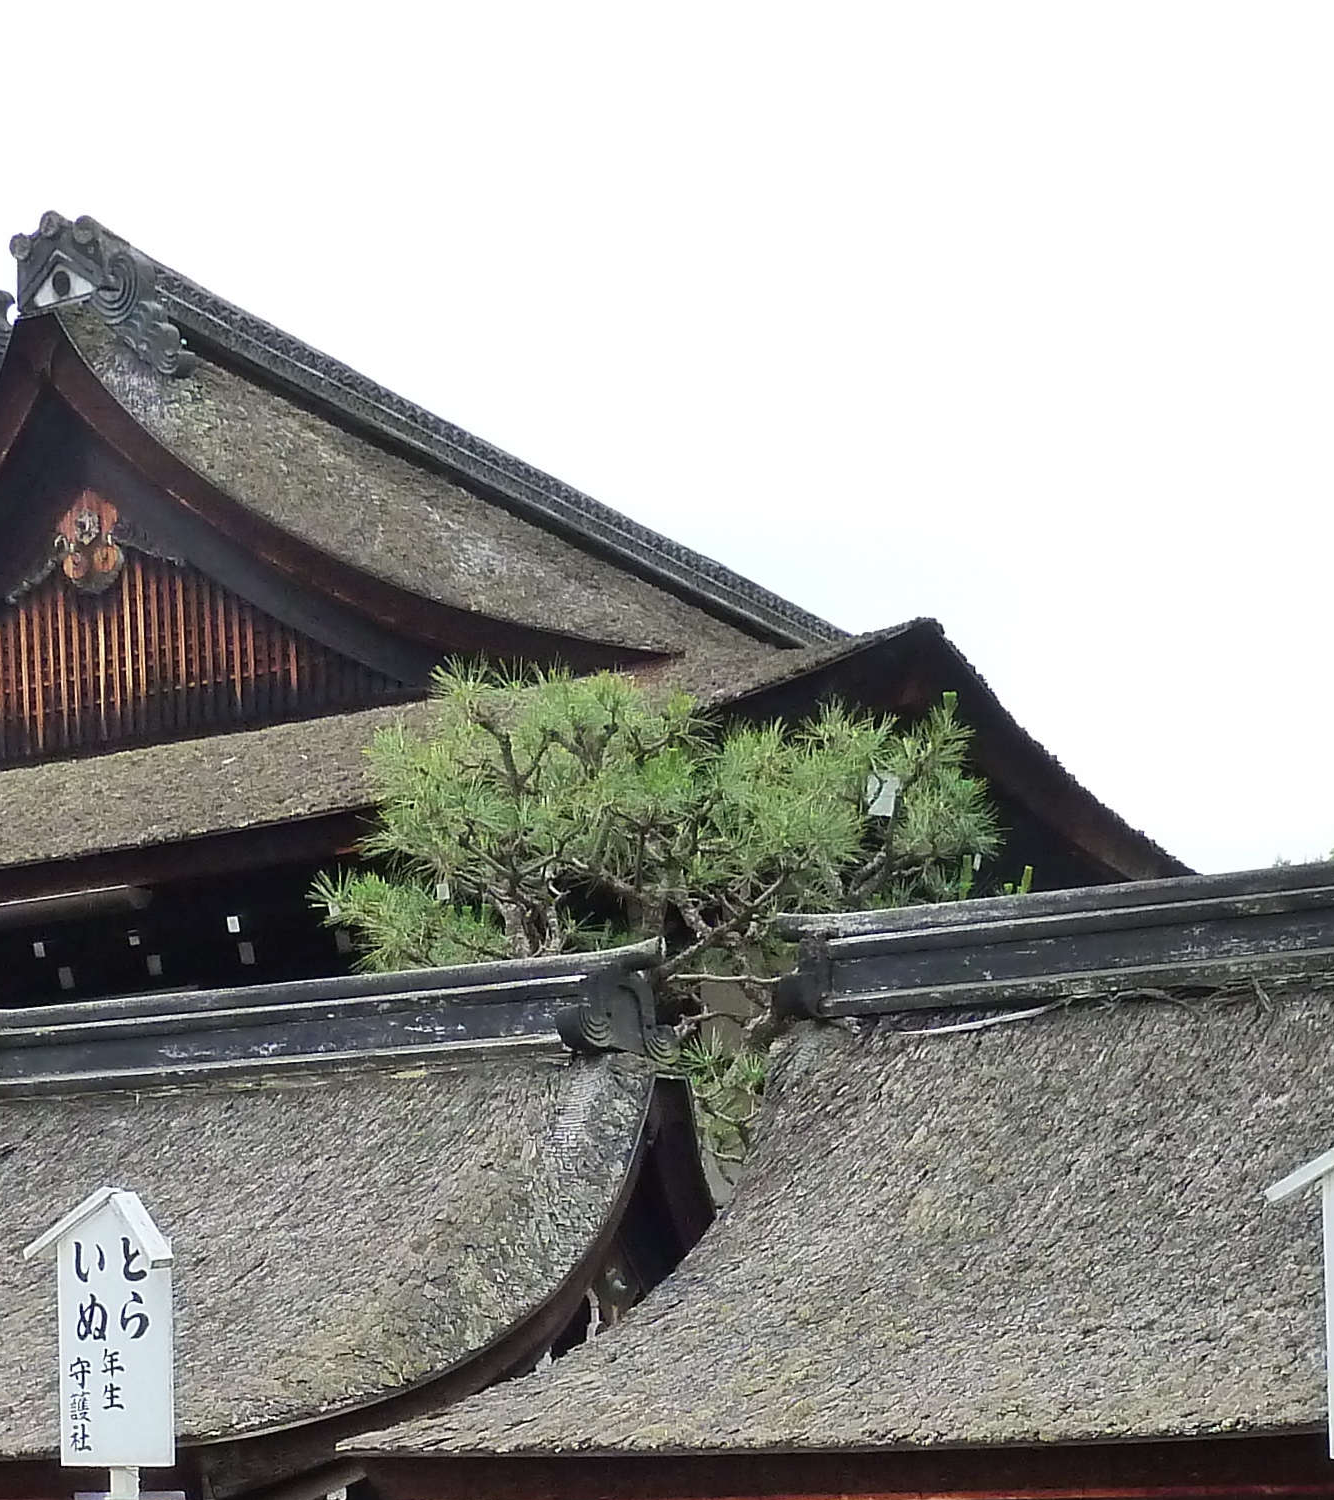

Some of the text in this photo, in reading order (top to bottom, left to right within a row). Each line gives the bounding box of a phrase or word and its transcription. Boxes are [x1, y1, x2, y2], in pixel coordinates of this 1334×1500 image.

[73, 1240, 109, 1342] いぬ
[120, 1236, 150, 1340] とら
[68, 1356, 93, 1453] 守護社
[100, 1348, 126, 1411] 年生
